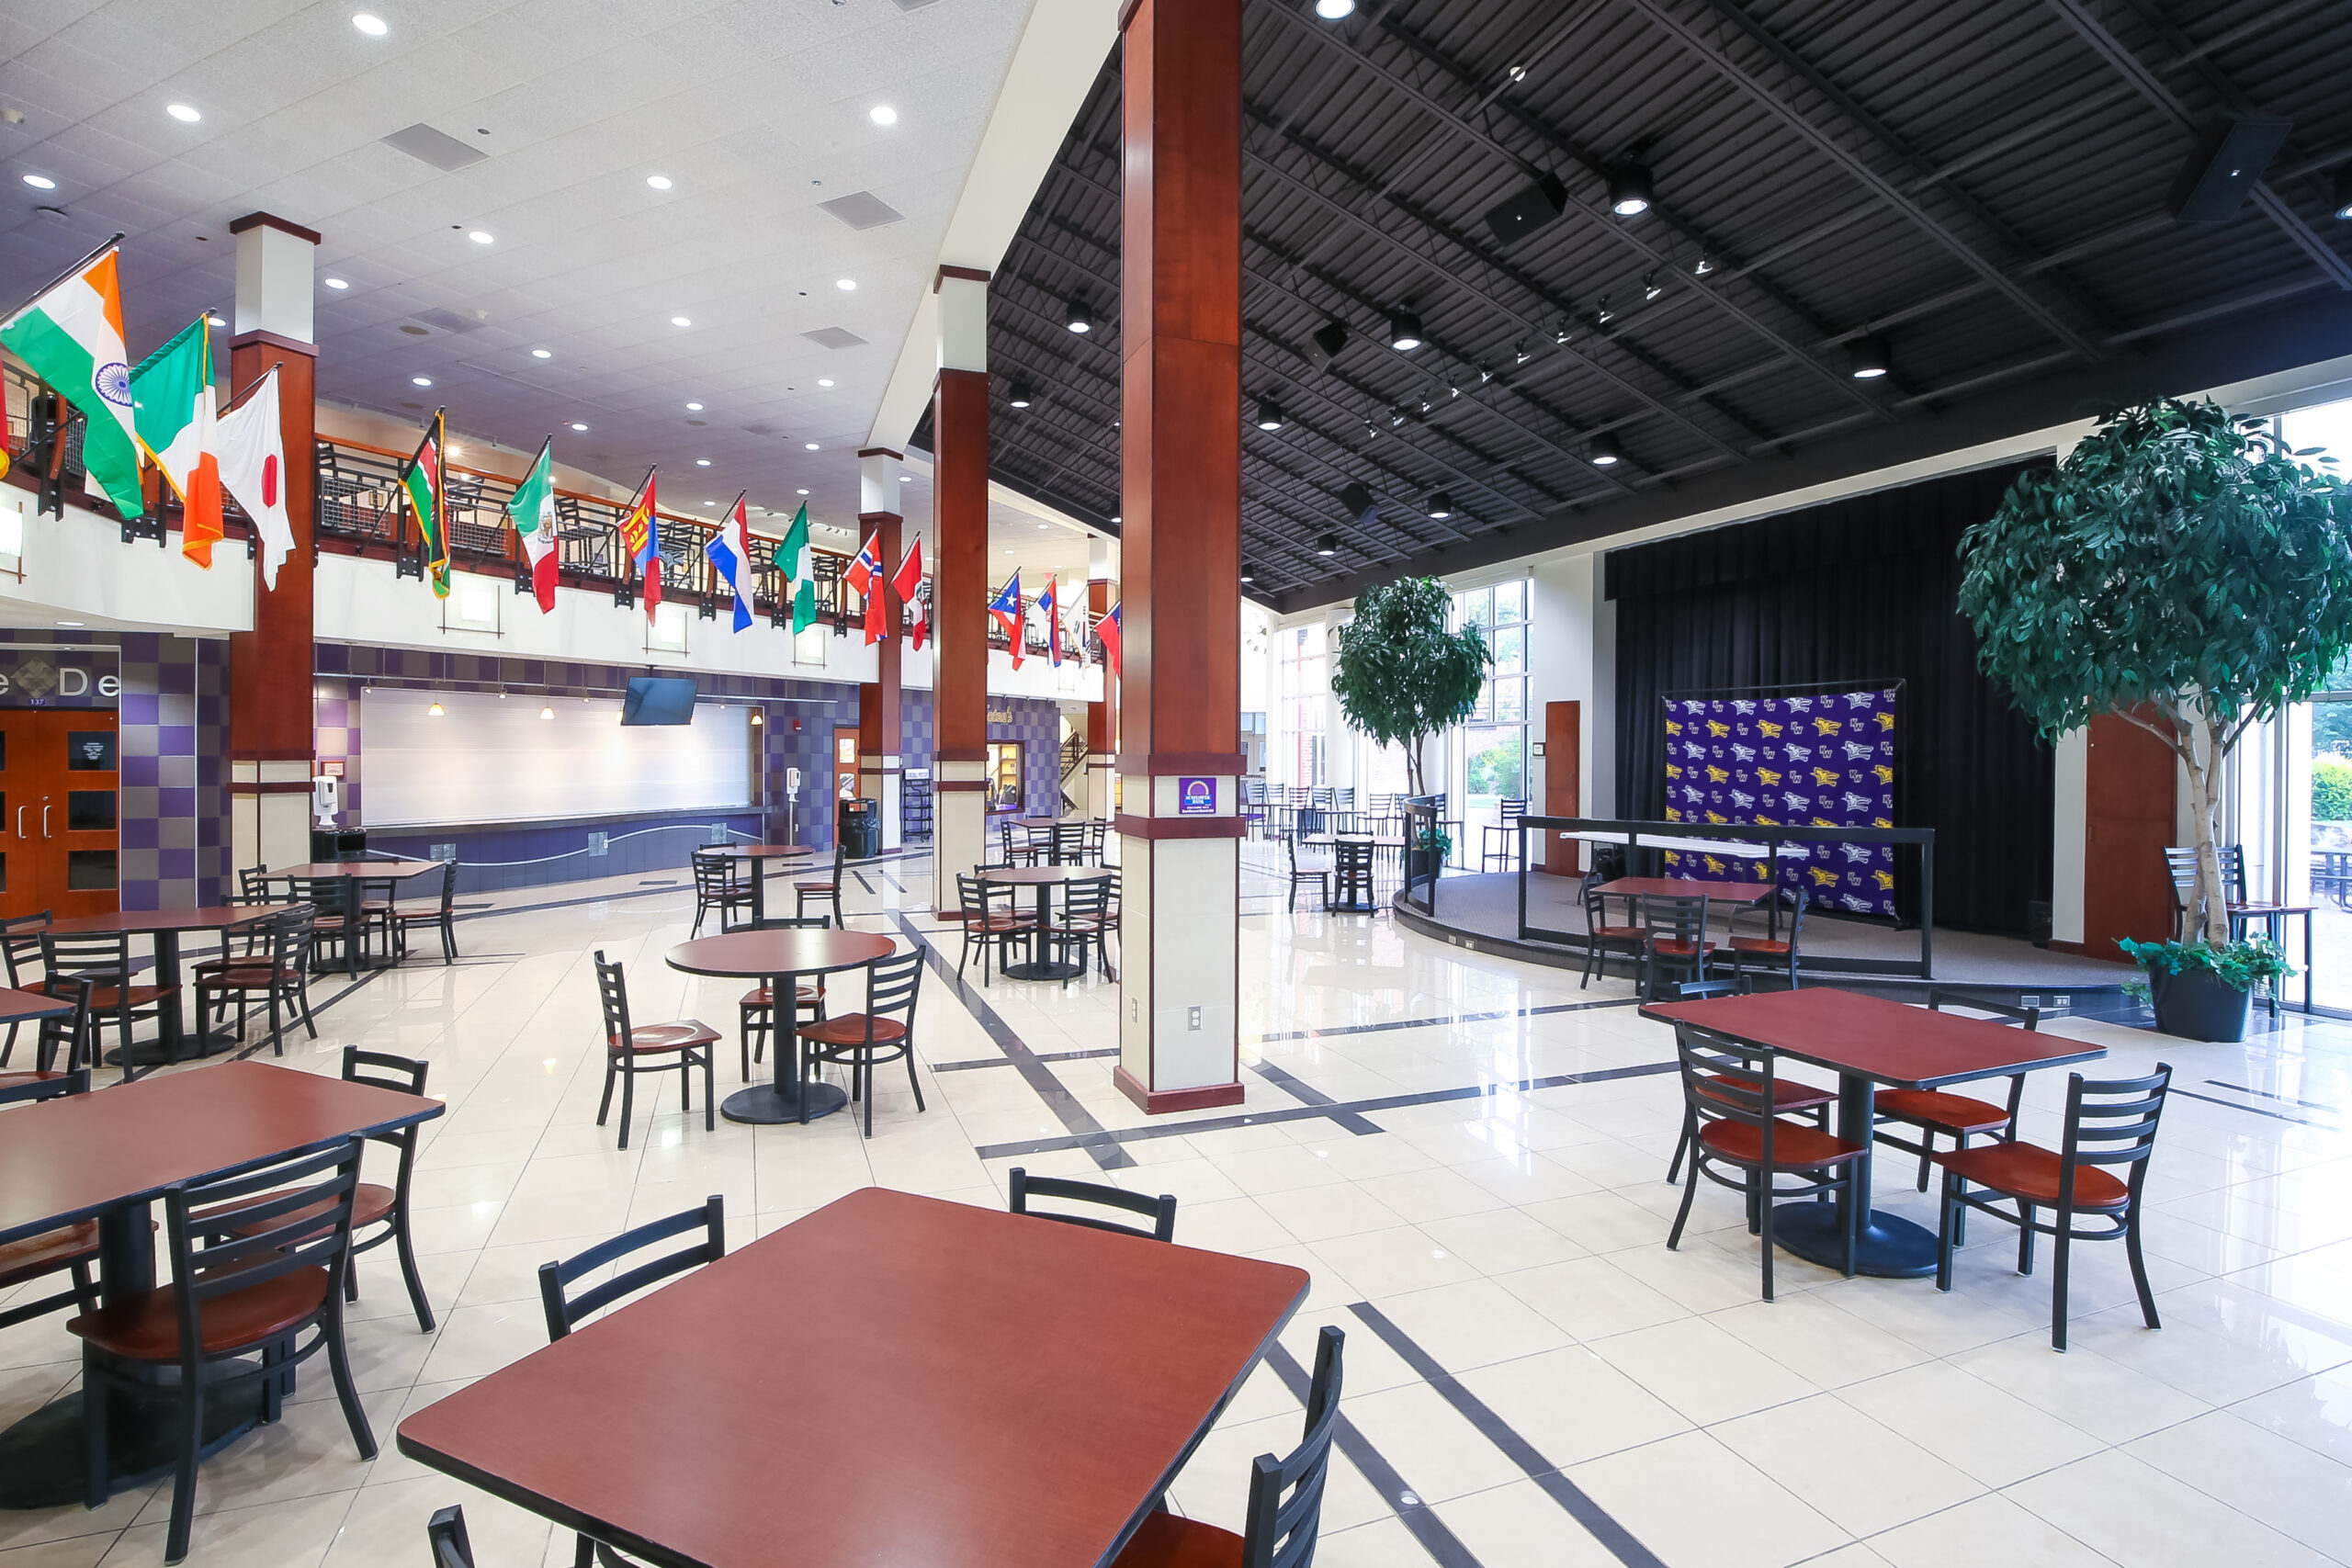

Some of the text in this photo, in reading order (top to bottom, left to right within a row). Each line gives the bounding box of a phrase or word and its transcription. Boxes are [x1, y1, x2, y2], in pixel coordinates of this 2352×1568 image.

[1764, 699, 1776, 712] KW
[1820, 695, 1834, 708] KW
[1791, 721, 1804, 735] KW
[1849, 718, 1864, 732] KW
[1763, 746, 1775, 760] KW
[1819, 745, 1833, 759] KW
[1790, 771, 1802, 784] KW
[1849, 770, 1863, 783] KW
[1763, 794, 1775, 807] KW
[1819, 795, 1834, 808] KW
[1817, 845, 1830, 859] KW
[1786, 868, 1799, 882] KW
[1848, 872, 1861, 886] KW
